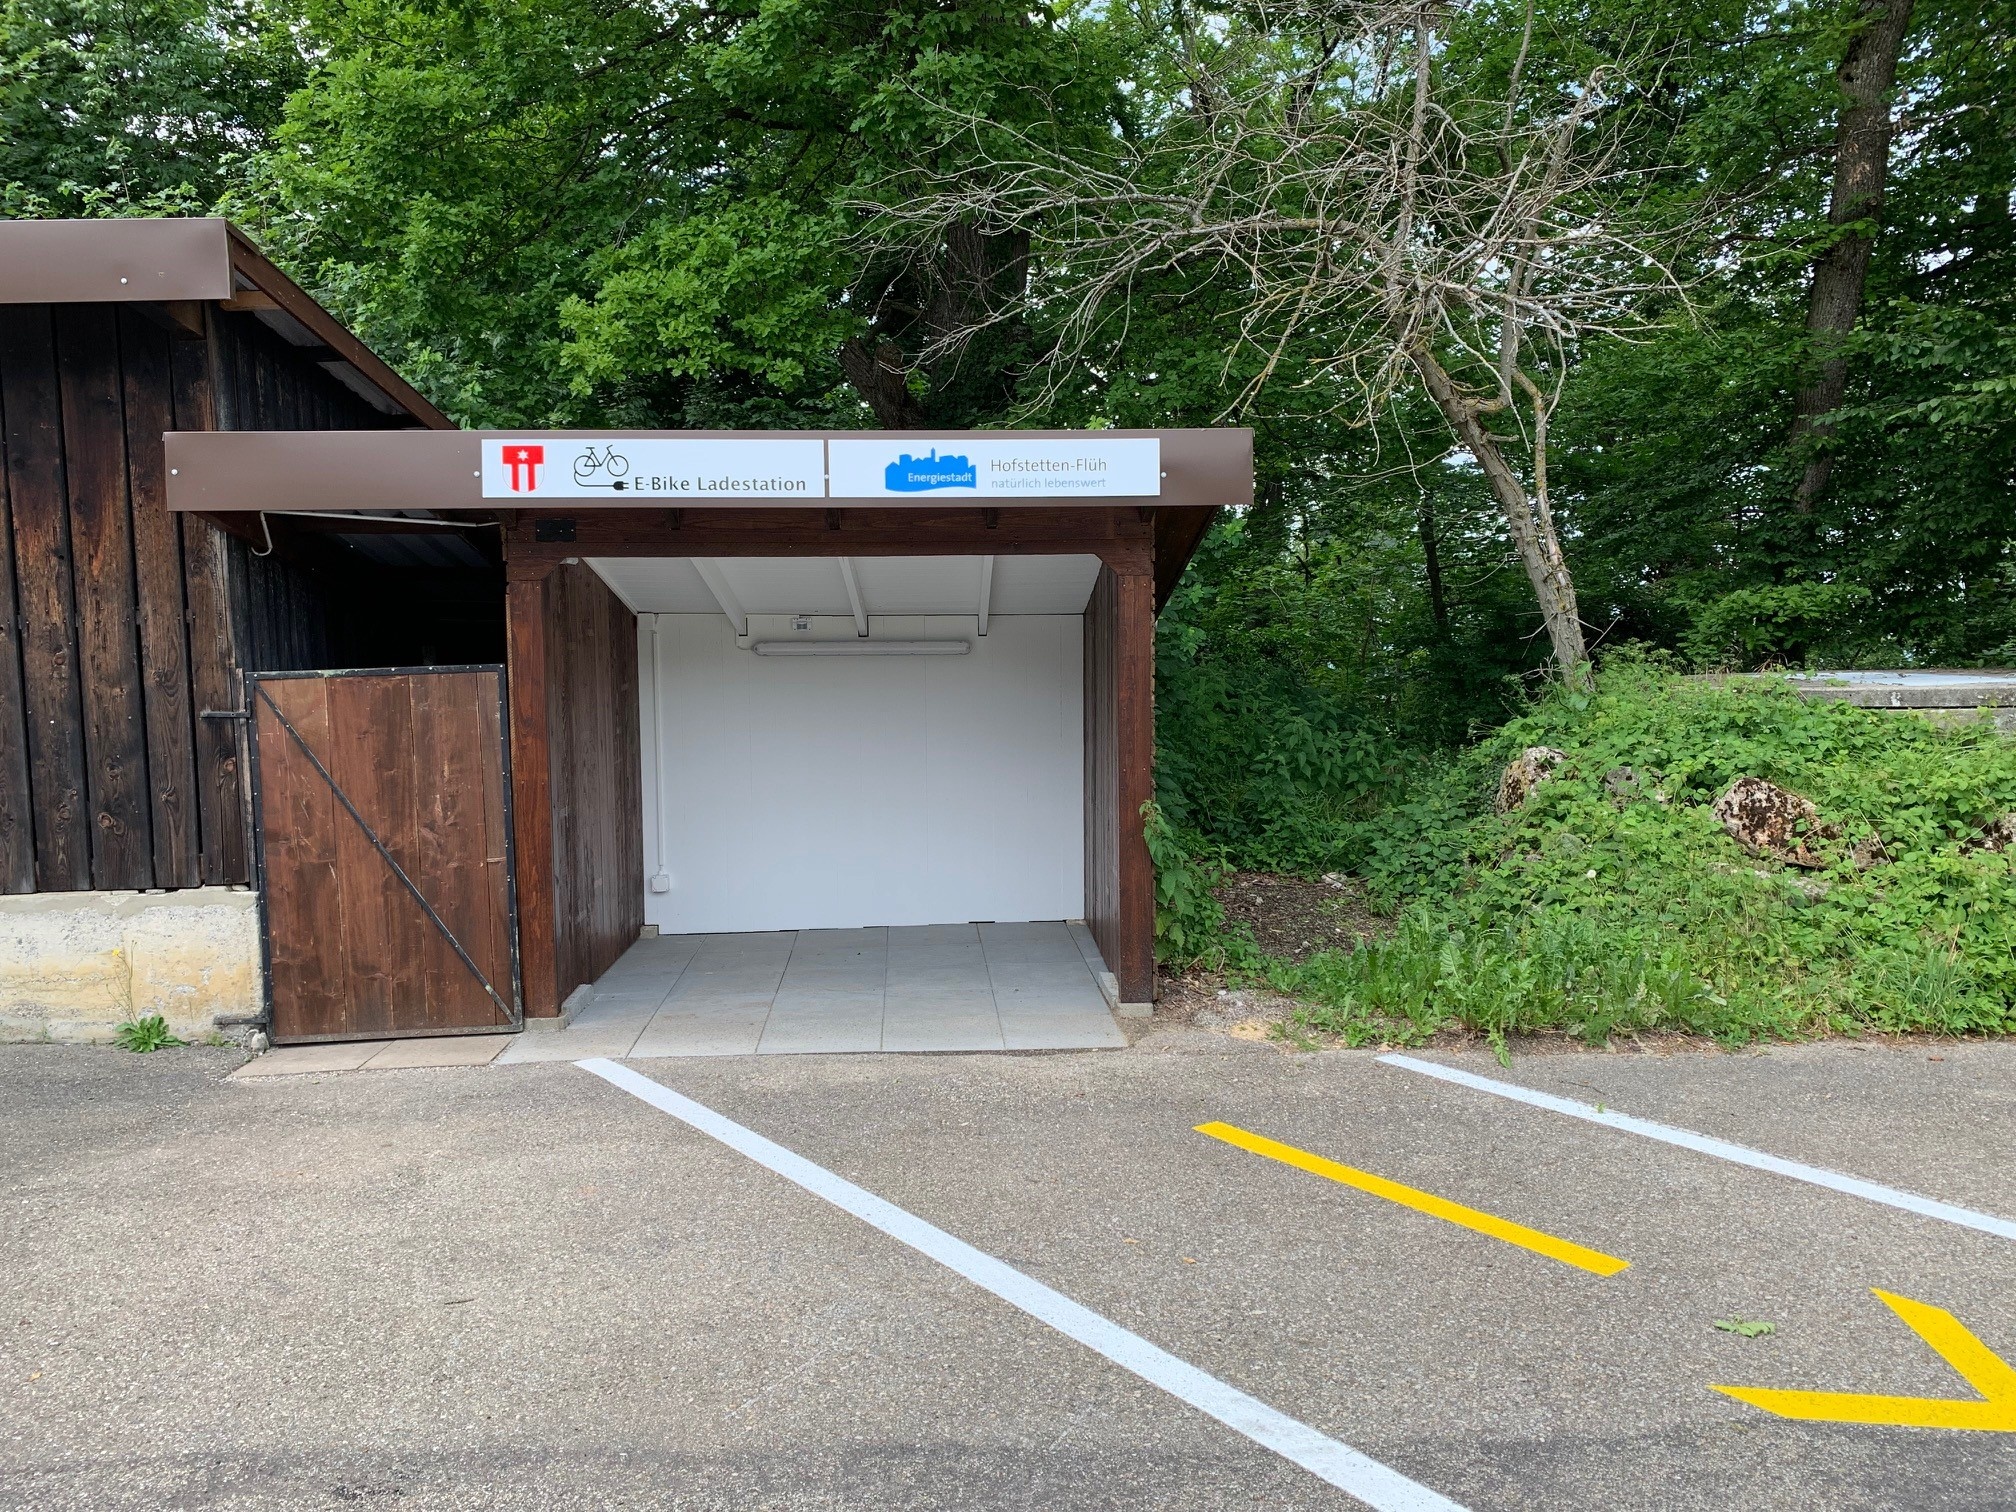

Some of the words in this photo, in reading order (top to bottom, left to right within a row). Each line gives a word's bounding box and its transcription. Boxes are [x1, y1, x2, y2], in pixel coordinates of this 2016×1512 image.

[990, 458, 1107, 472] Hofstetten-Flüh
[634, 476, 691, 491] E-Bike
[697, 476, 807, 491] Ladestation
[907, 471, 973, 485] Energiestadt
[991, 477, 1042, 489] natürlich
[1044, 477, 1107, 488] lebenswert
